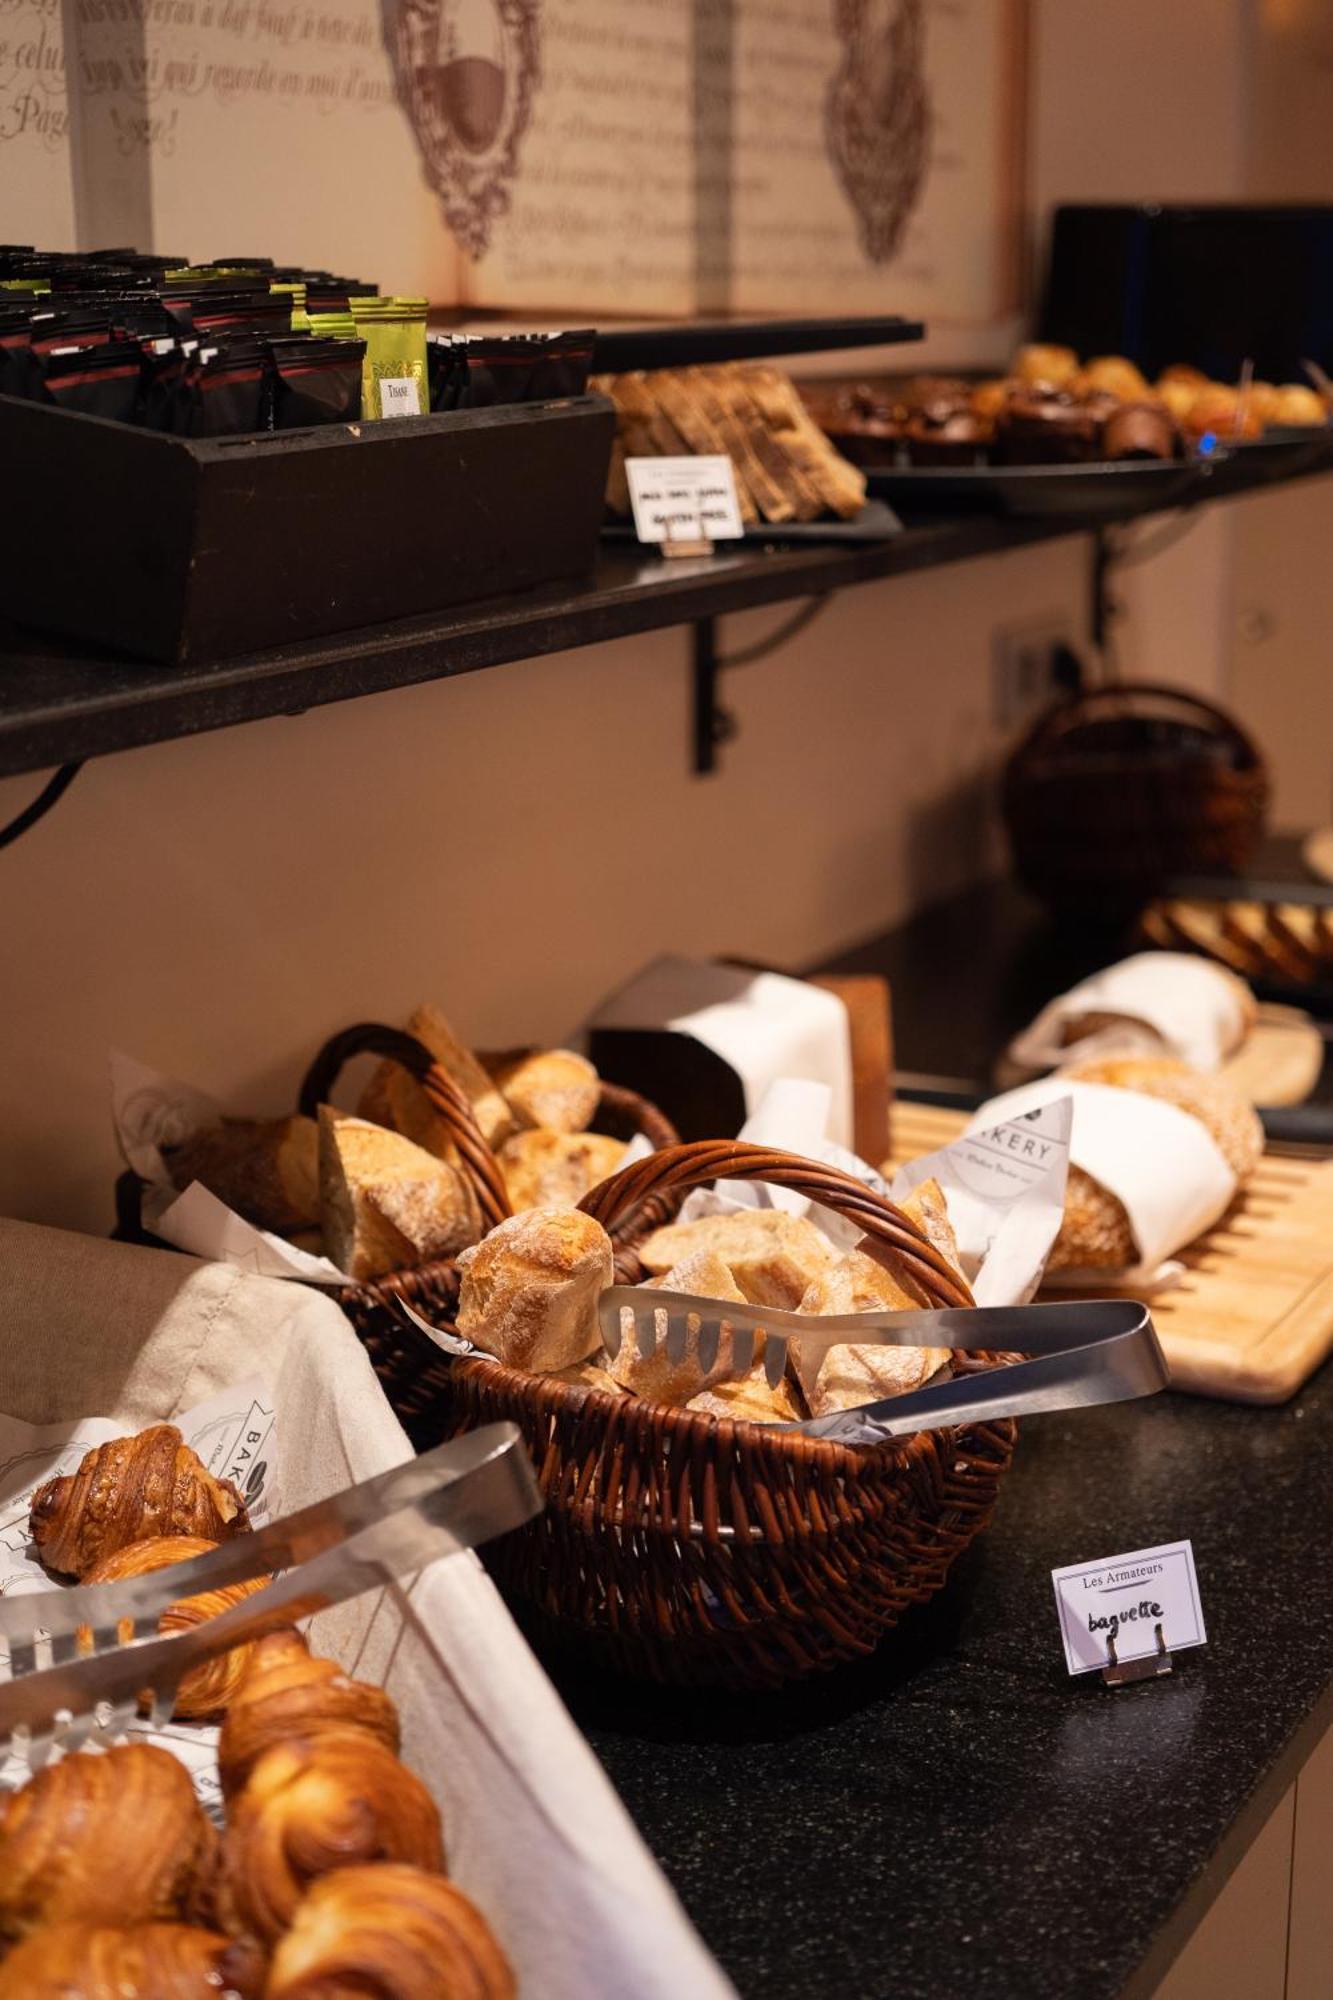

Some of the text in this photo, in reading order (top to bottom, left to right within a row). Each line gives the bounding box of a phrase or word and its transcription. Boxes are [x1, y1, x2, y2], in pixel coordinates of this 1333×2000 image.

[981, 1126, 1051, 1159] KERY
[1082, 1563, 1163, 1589] Les Armateurs
[1088, 1600, 1165, 1640] baguette
